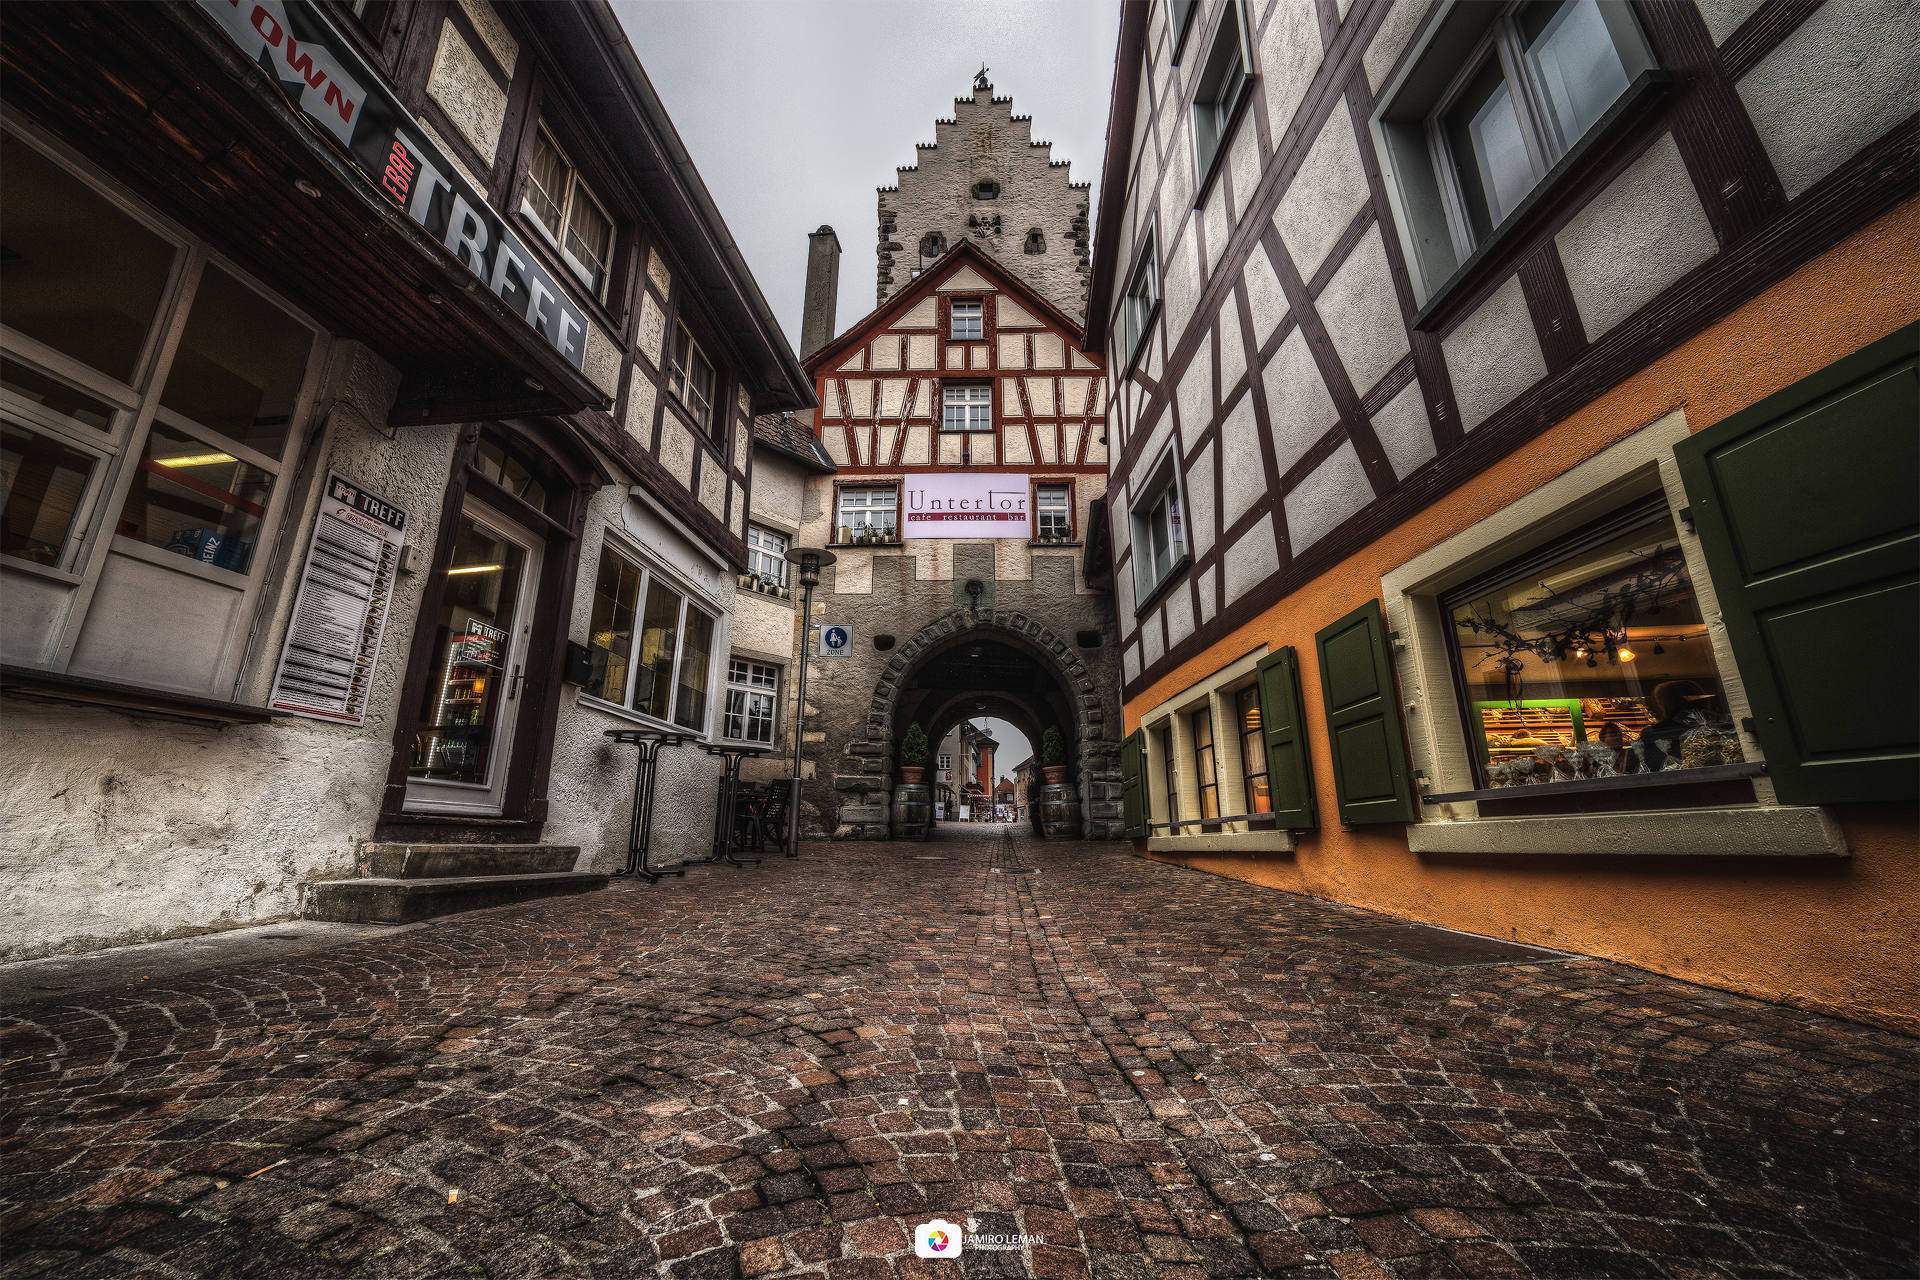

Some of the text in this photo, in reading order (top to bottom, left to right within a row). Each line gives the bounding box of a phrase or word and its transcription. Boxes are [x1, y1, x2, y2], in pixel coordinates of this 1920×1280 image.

[229, 0, 355, 124] OWN
[382, 141, 415, 209] EBAP
[361, 493, 404, 526] TREFF
[942, 513, 997, 521] restaurant
[1007, 512, 1025, 521] bar
[484, 627, 505, 642] TREFF
